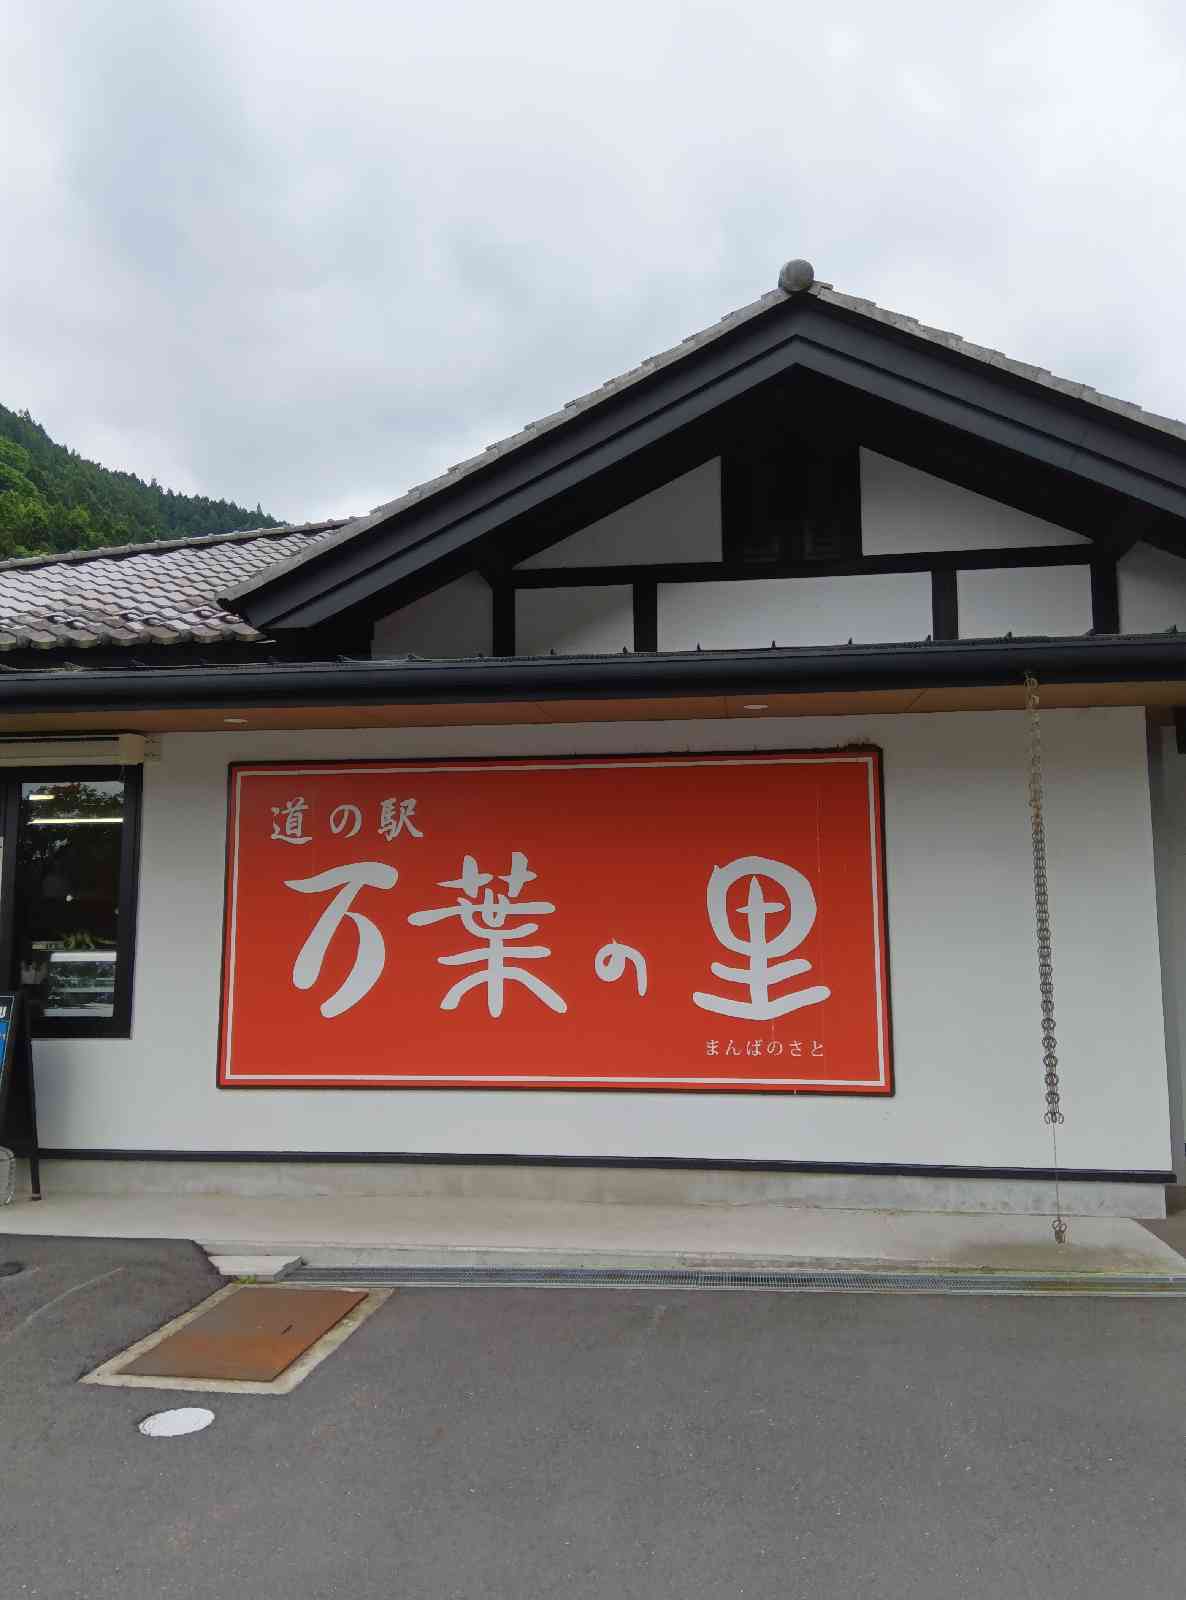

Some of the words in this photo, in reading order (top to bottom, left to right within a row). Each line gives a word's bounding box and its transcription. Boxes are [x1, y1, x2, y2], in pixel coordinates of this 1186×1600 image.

[270, 796, 424, 845] 道の駅
[283, 852, 832, 1021] 万葉の里
[706, 1039, 824, 1057] まんばのさと
